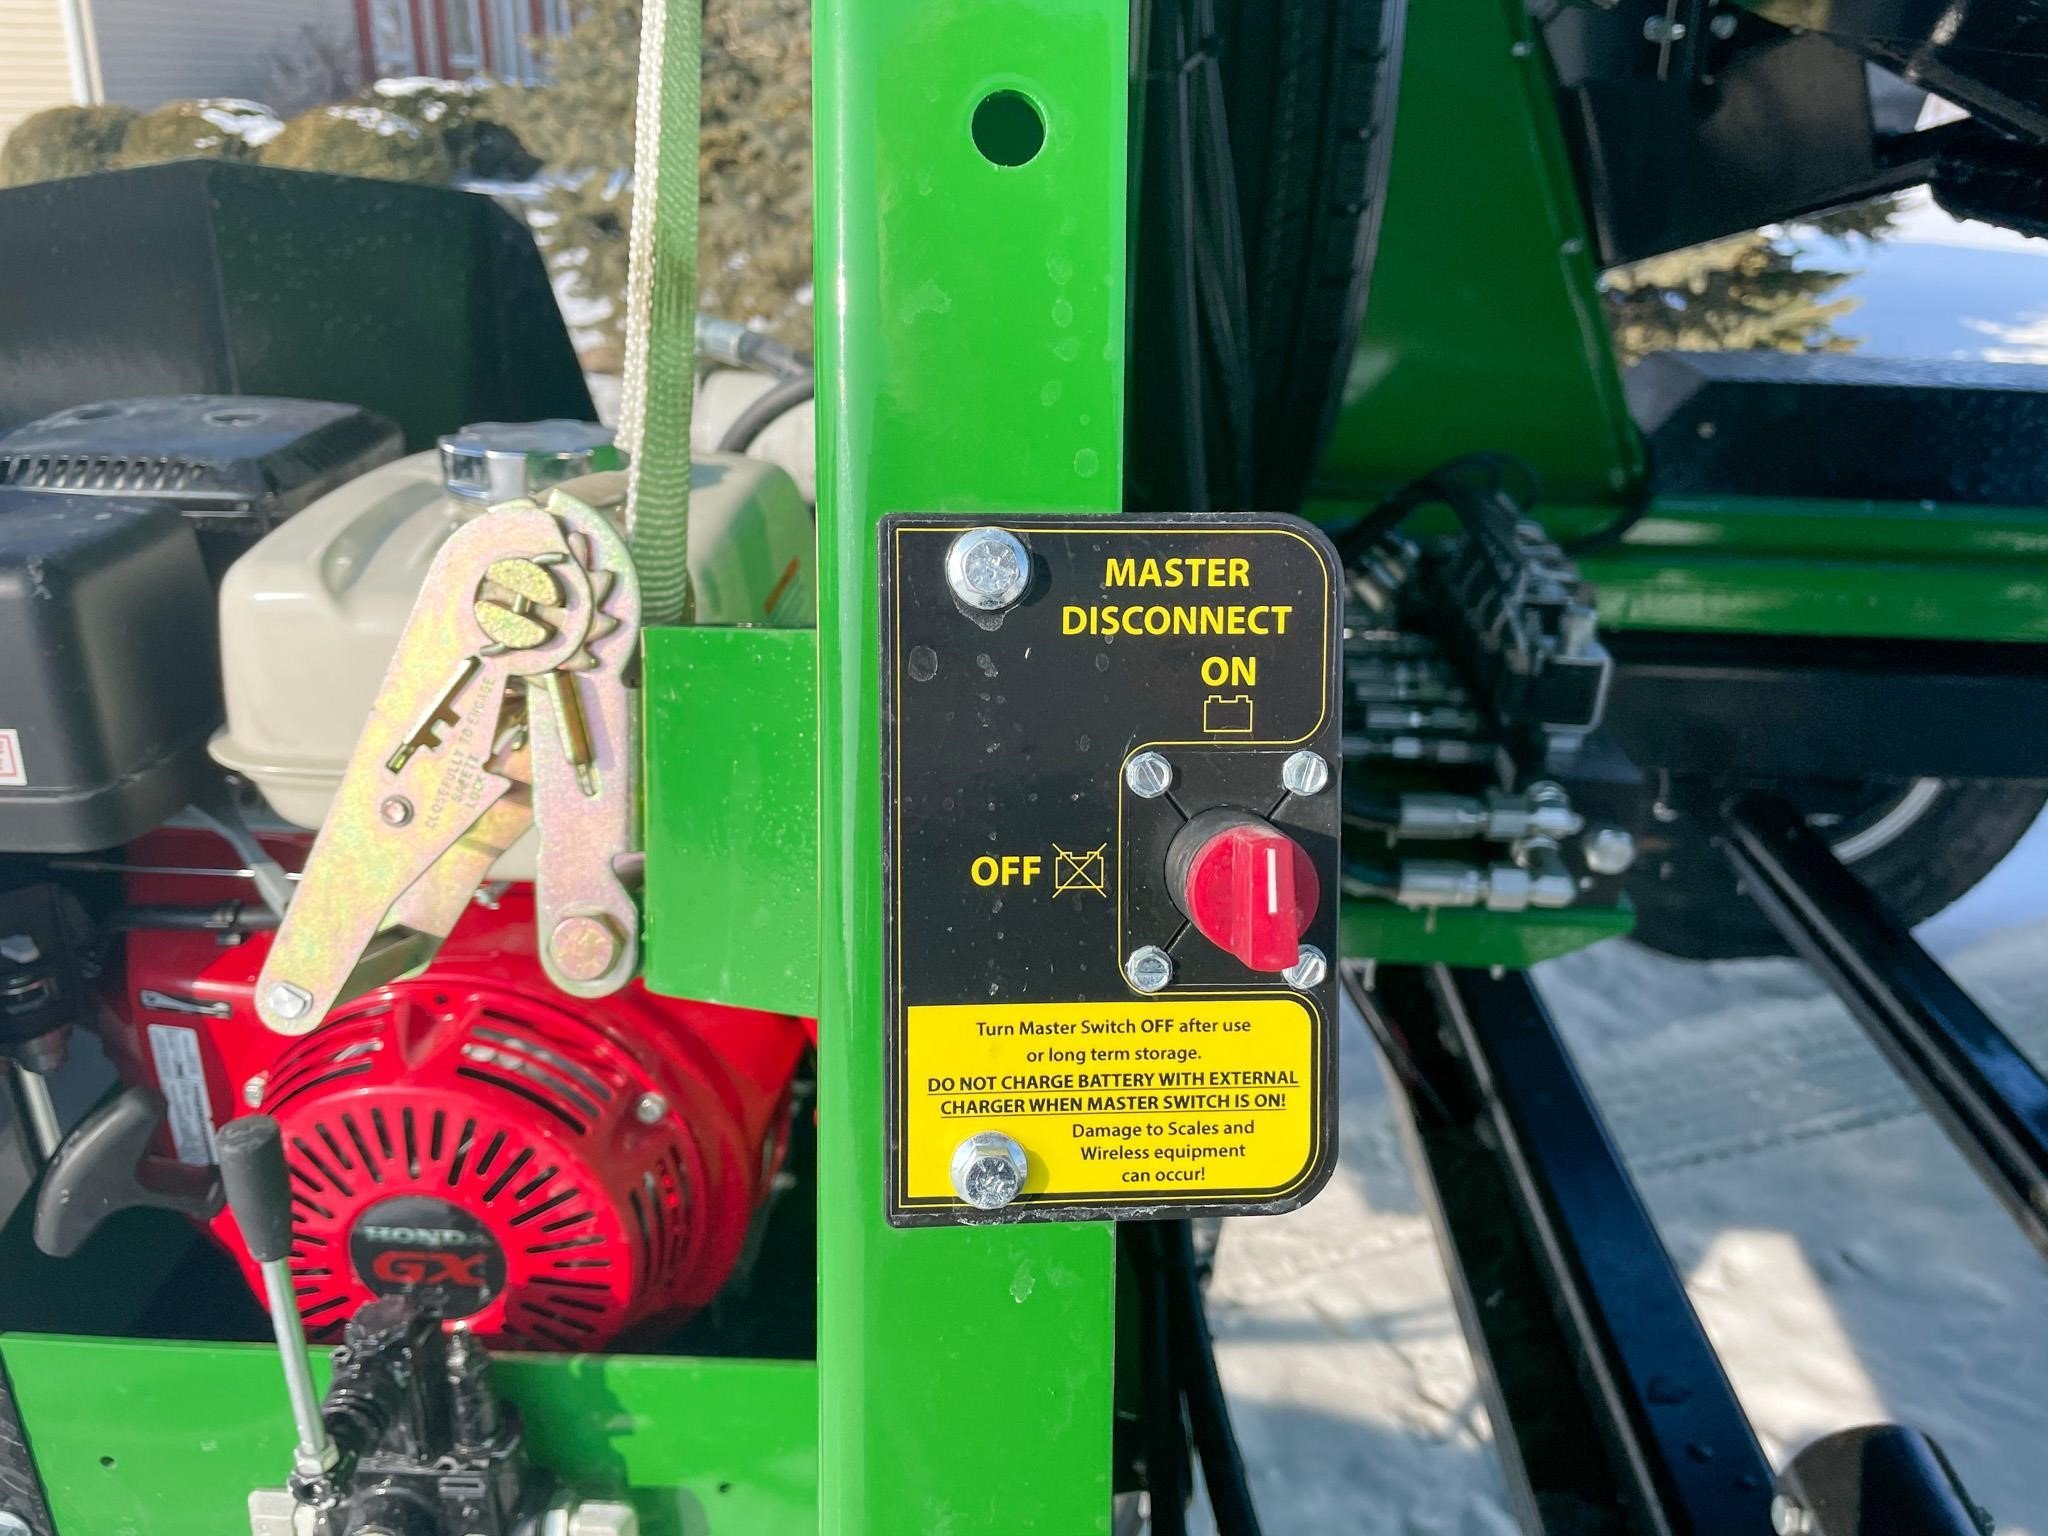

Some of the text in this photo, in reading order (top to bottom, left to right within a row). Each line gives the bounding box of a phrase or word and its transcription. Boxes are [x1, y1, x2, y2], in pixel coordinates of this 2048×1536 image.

[1105, 558, 1249, 587] MASTER
[1063, 606, 1292, 637] DISCONNECT
[1201, 657, 1256, 686] ON
[971, 856, 1041, 886] OFF
[976, 1018, 1251, 1036] Turn Master Switch OFF after use
[1026, 1047, 1201, 1064] or long term storage.
[928, 1070, 1299, 1091] DO NOT CHARGE BATTERY WITH EXTERNAL
[941, 1093, 1286, 1115] CHARGER WHEN MASTER SWITCH IS ON!
[1072, 1120, 1254, 1140] Damage to Scales and
[1080, 1144, 1246, 1161] Wireless equipment
[1122, 1167, 1205, 1183] can occur!
[364, 1225, 492, 1247] HONDA
[373, 1250, 488, 1287] GX
